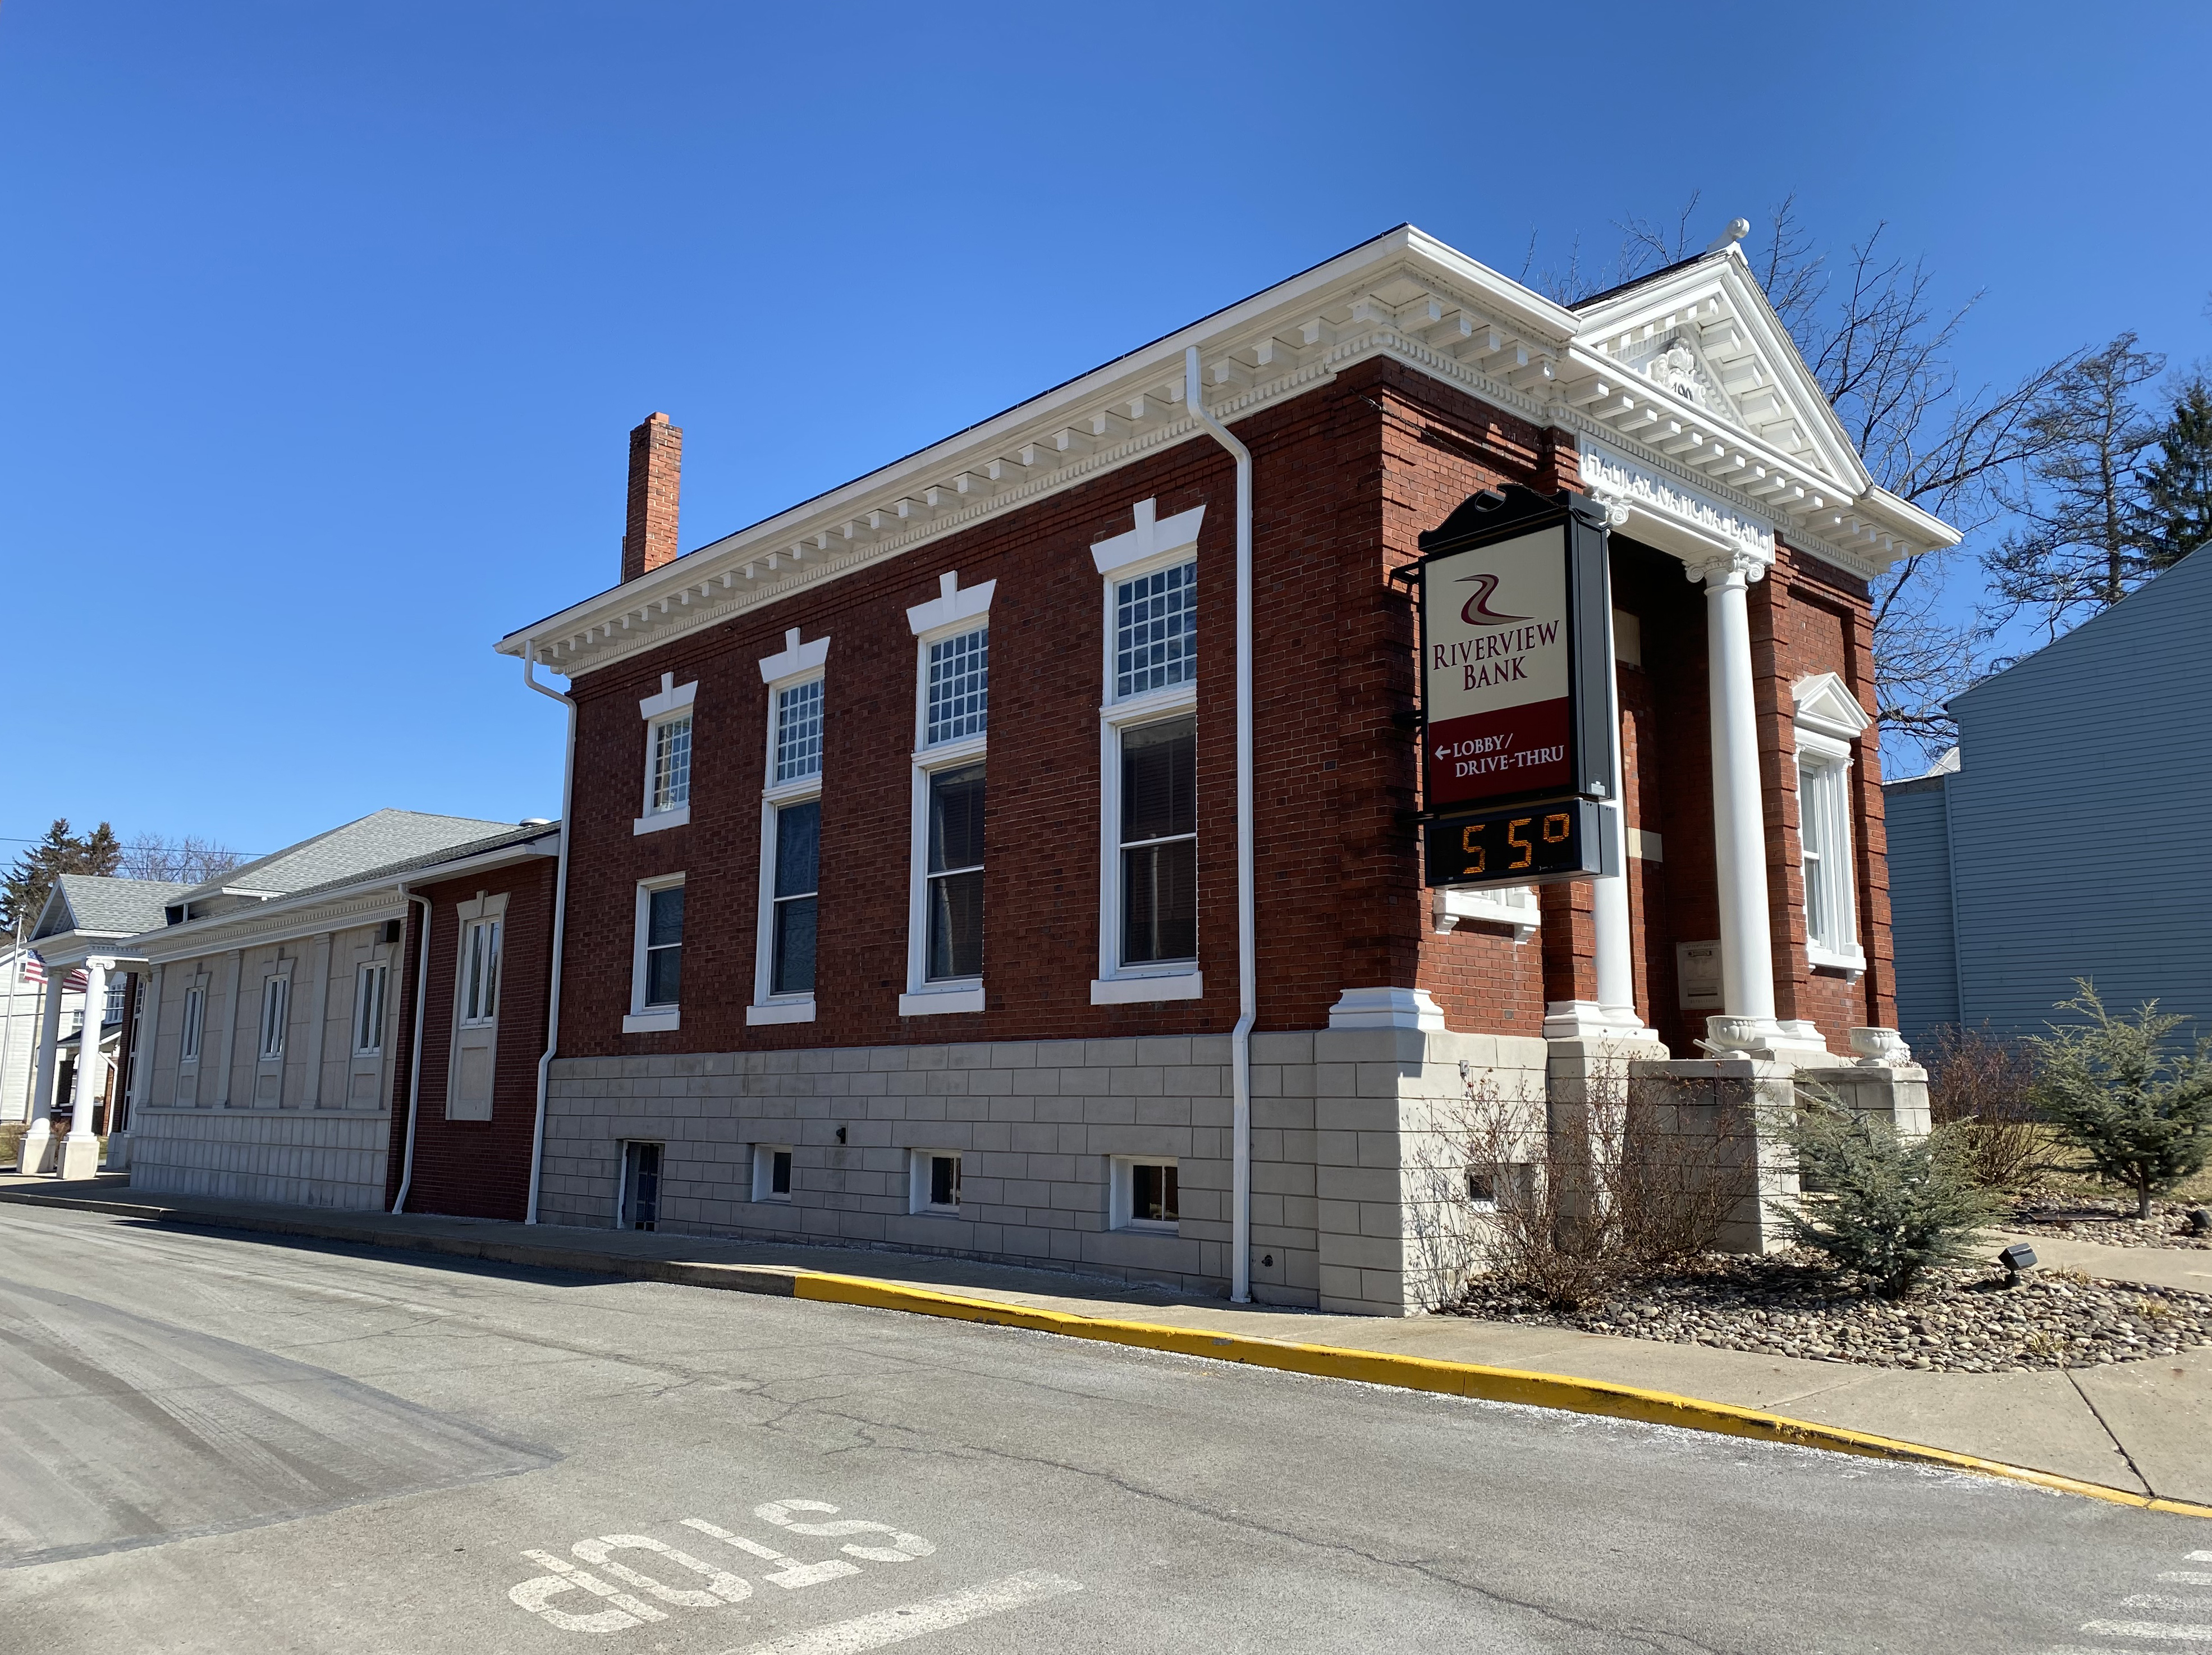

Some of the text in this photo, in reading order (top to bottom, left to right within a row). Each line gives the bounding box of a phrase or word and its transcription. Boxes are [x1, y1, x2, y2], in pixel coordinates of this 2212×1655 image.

[1656, 485, 1728, 531] NATIONAL
[1730, 518, 1767, 549] BANK
[1432, 620, 1560, 670] RIVERVIEW
[1463, 656, 1528, 691] BANK
[1453, 733, 1513, 757] LOBBY/
[1455, 744, 1564, 778] DRIVE-THRU
[507, 1498, 936, 1633] STOP
